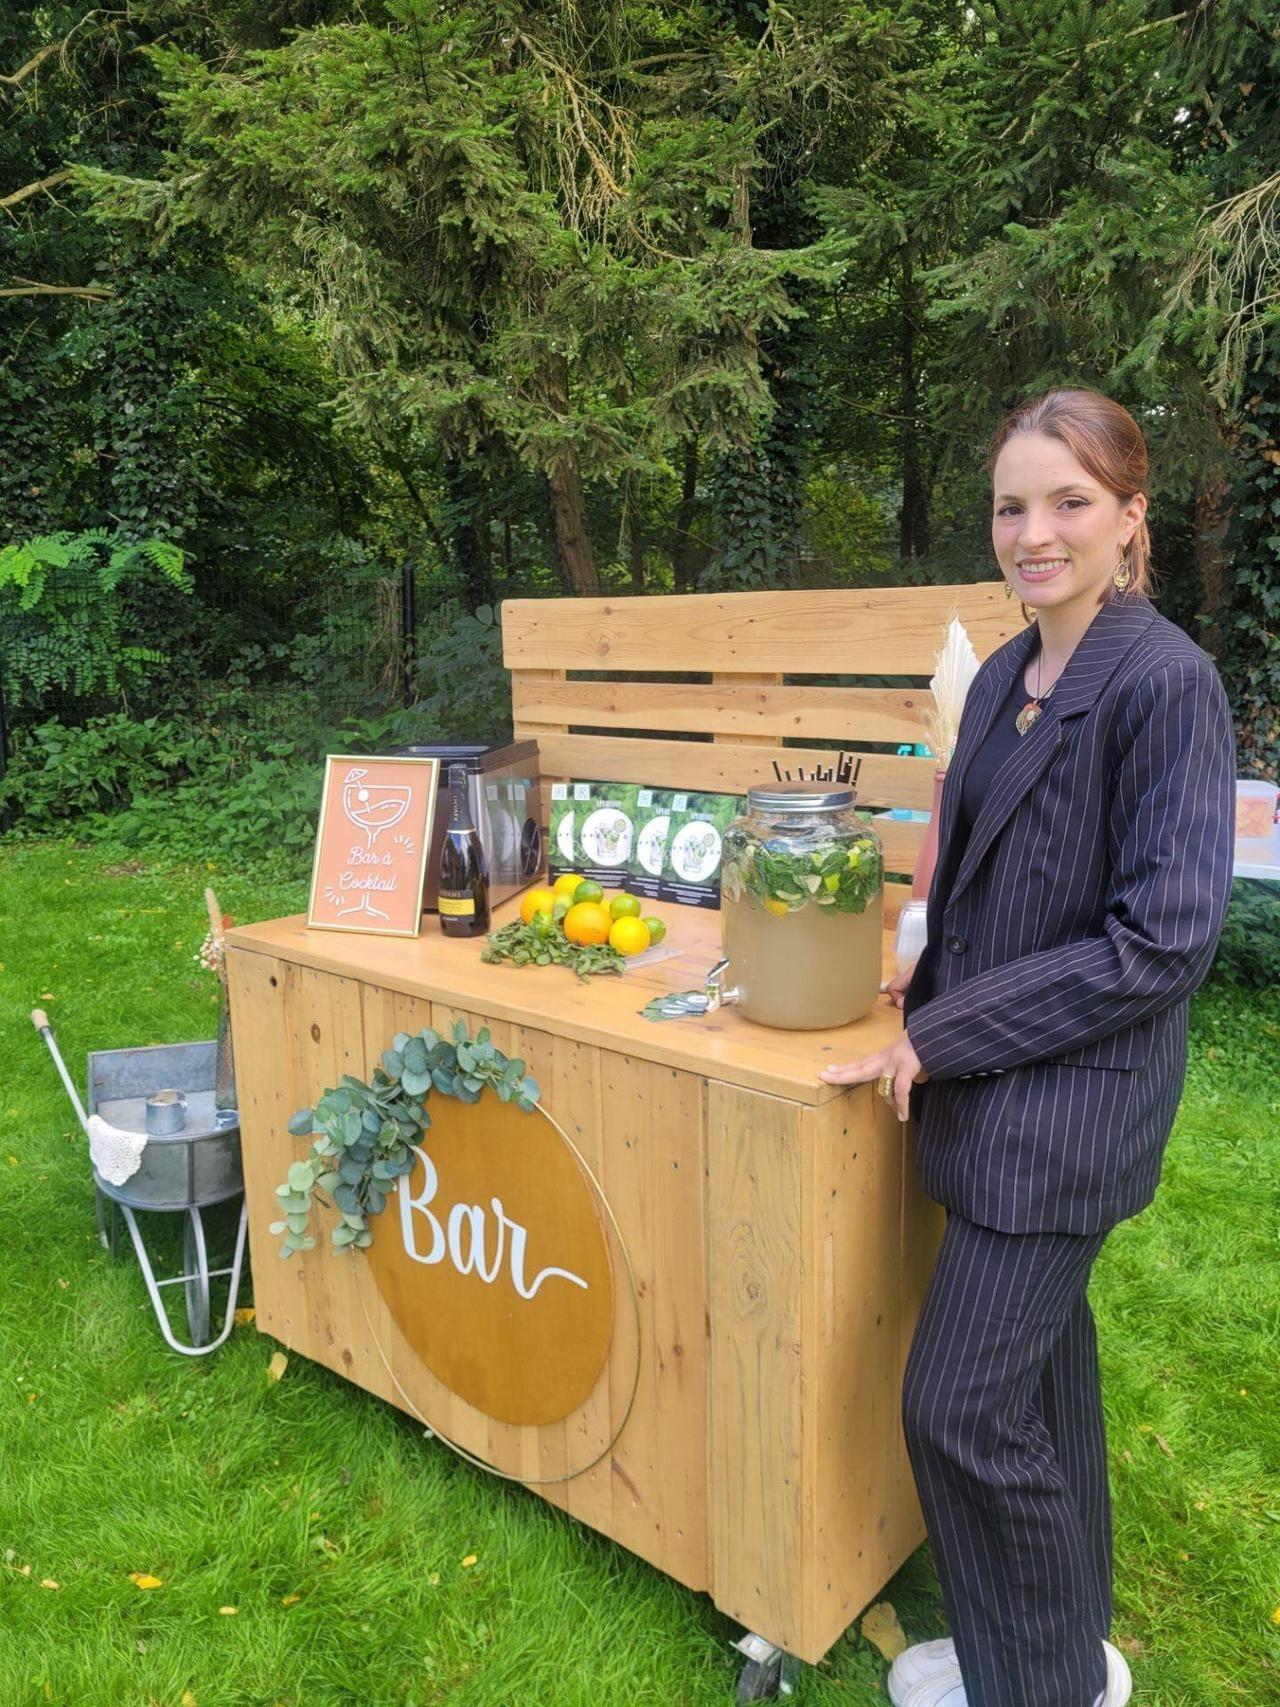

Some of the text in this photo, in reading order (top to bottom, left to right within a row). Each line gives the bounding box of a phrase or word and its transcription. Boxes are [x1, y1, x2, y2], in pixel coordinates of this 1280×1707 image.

[347, 846, 380, 865] Bar
[339, 870, 397, 891] Cocktail
[398, 1144, 588, 1299] Bar
